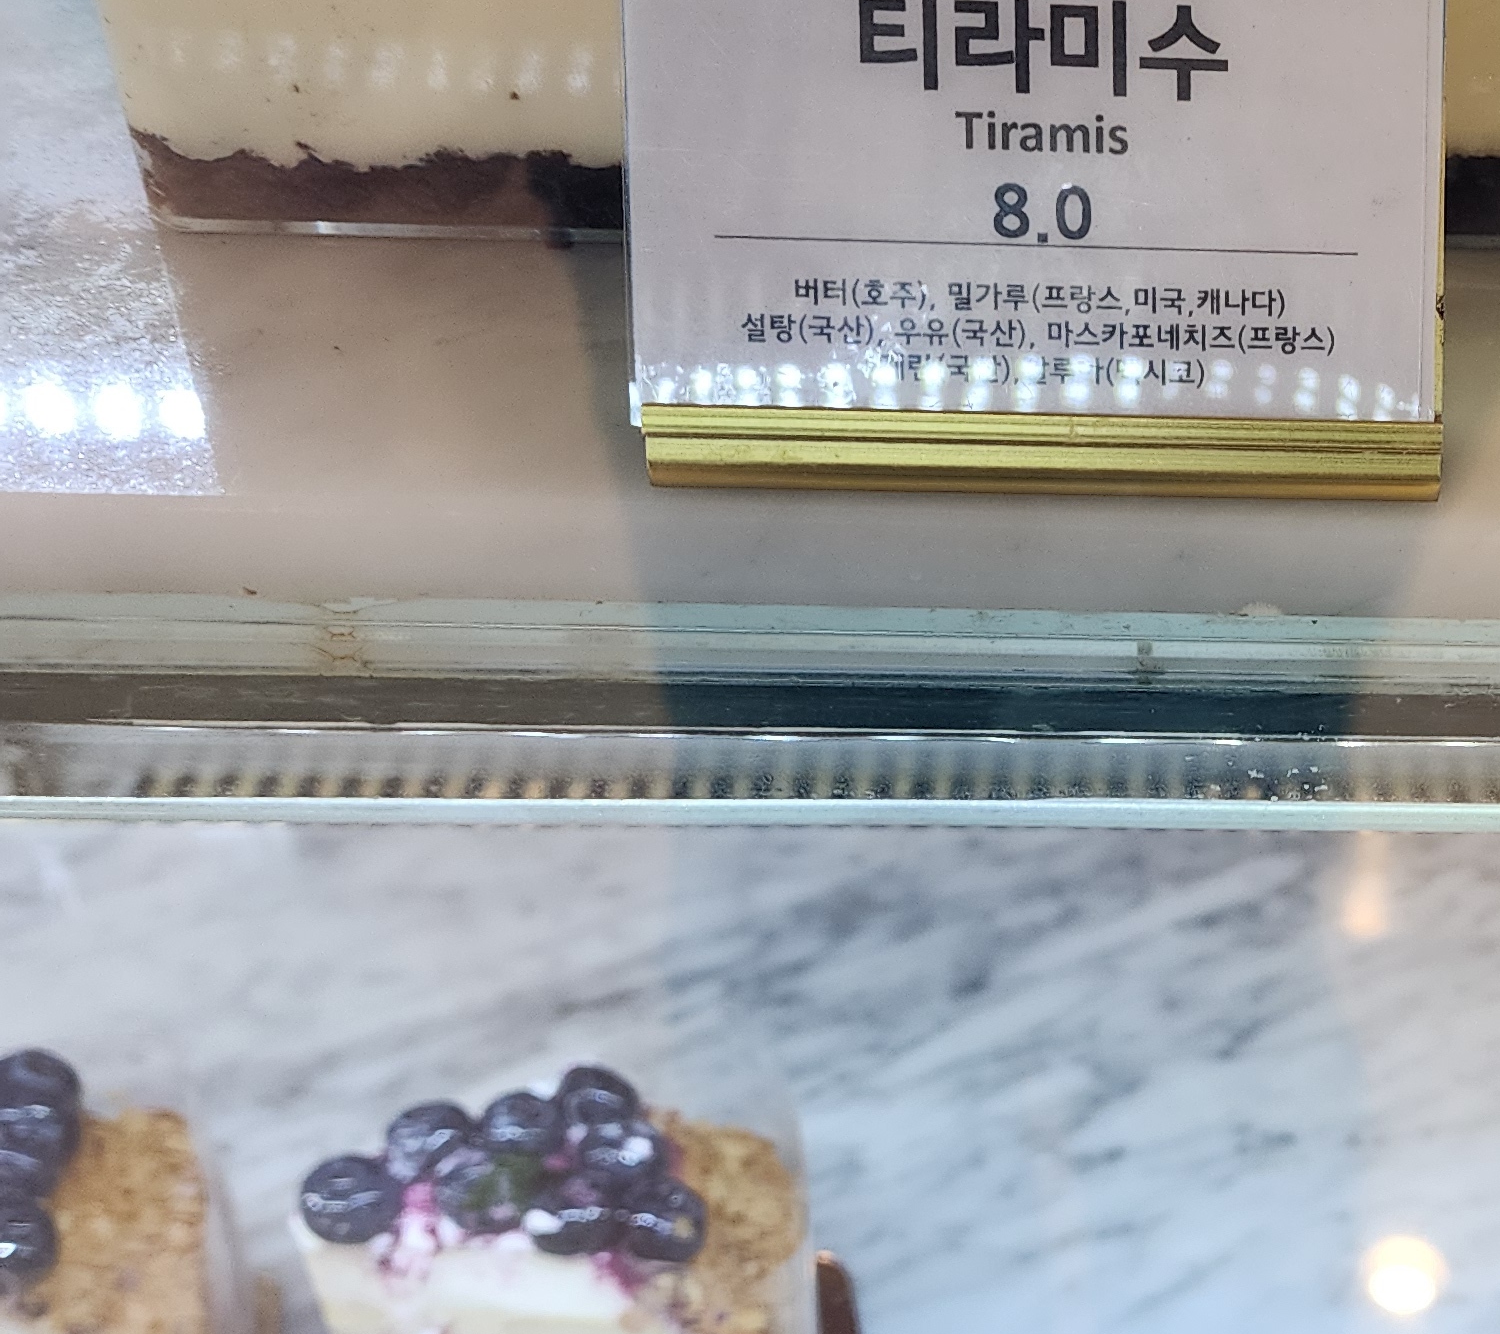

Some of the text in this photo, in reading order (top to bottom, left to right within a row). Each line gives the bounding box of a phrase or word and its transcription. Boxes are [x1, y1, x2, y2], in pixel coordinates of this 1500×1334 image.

[954, 110, 1129, 156] Tiramis
[993, 183, 1092, 244] 8.0
[794, 278, 1286, 319] 버터(호주), 밀가루(프랑스,미국,캐나다)
[740, 313, 1336, 357] 설탕(국산), 우유(국산), 마스카포네치즈(프랑스)
